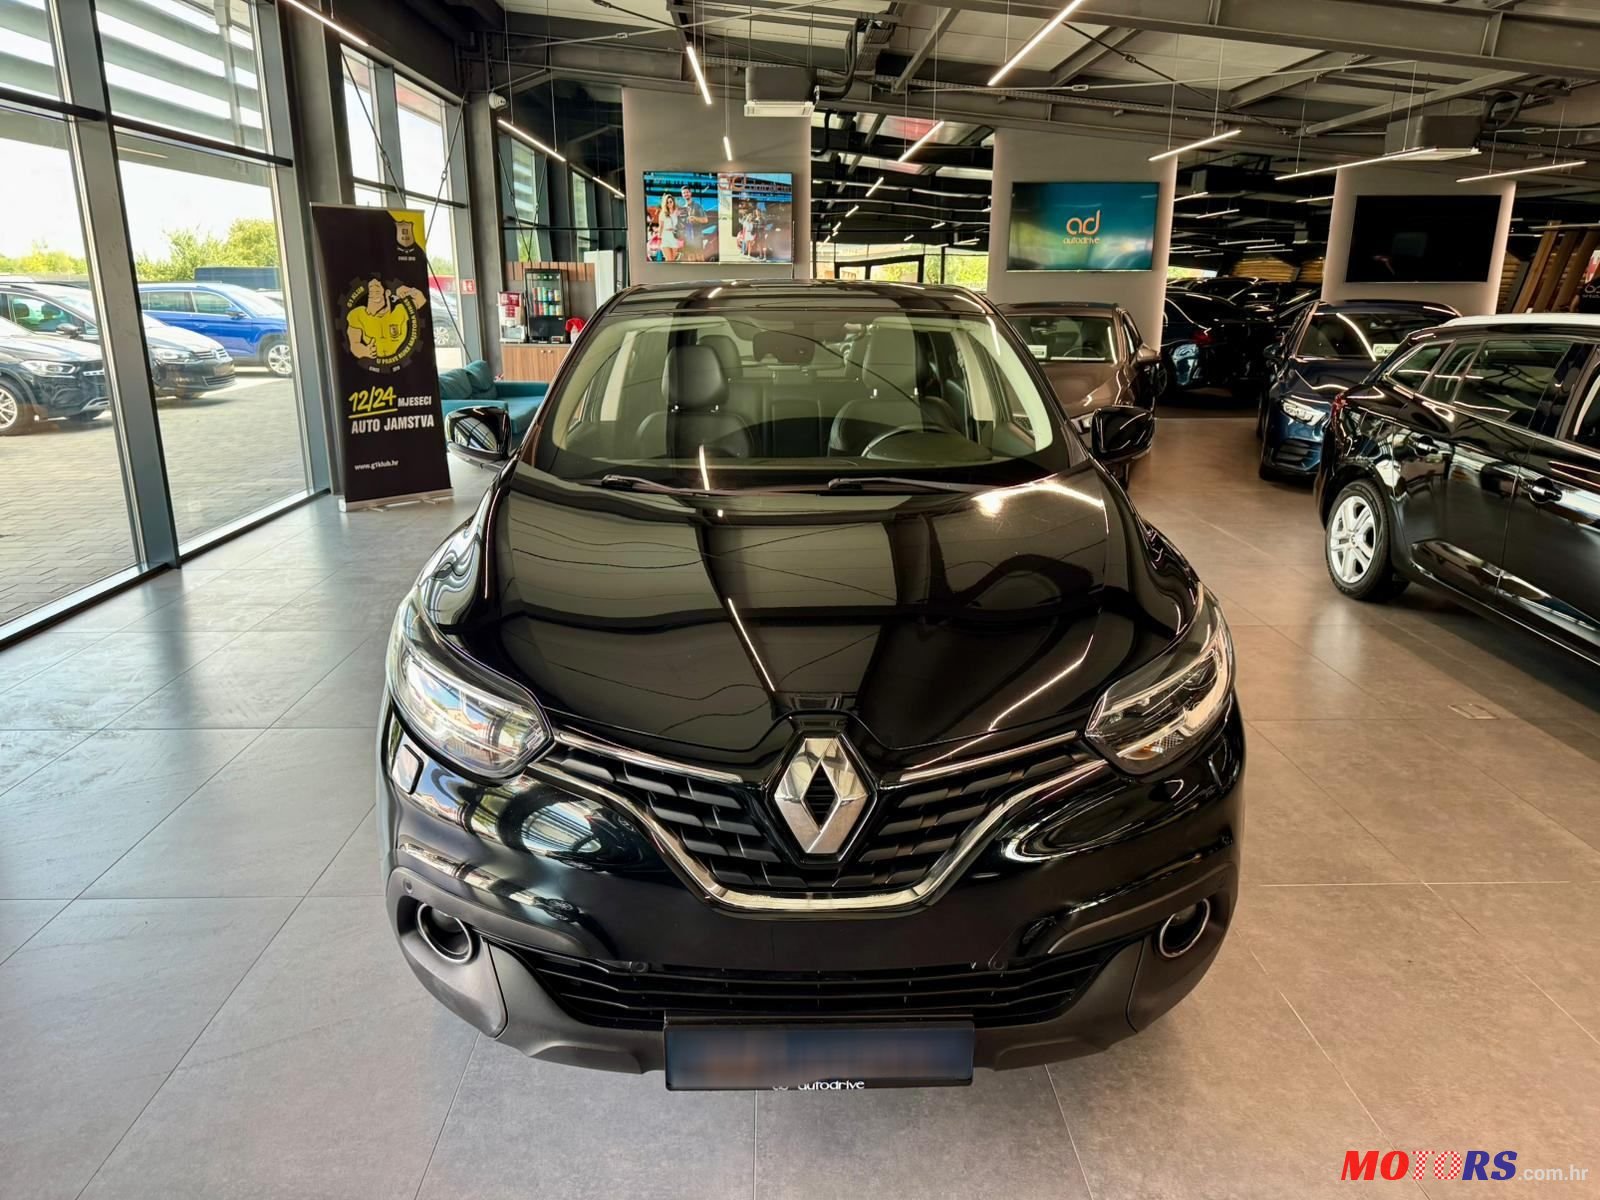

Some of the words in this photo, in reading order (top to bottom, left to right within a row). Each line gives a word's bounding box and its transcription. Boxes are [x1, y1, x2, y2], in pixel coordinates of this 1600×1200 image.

[1066, 209, 1101, 235] ad
[348, 386, 397, 412] 12/24
[398, 395, 432, 407] MJESECI
[351, 418, 381, 434] AUTO
[383, 414, 434, 431] JAMSTVA
